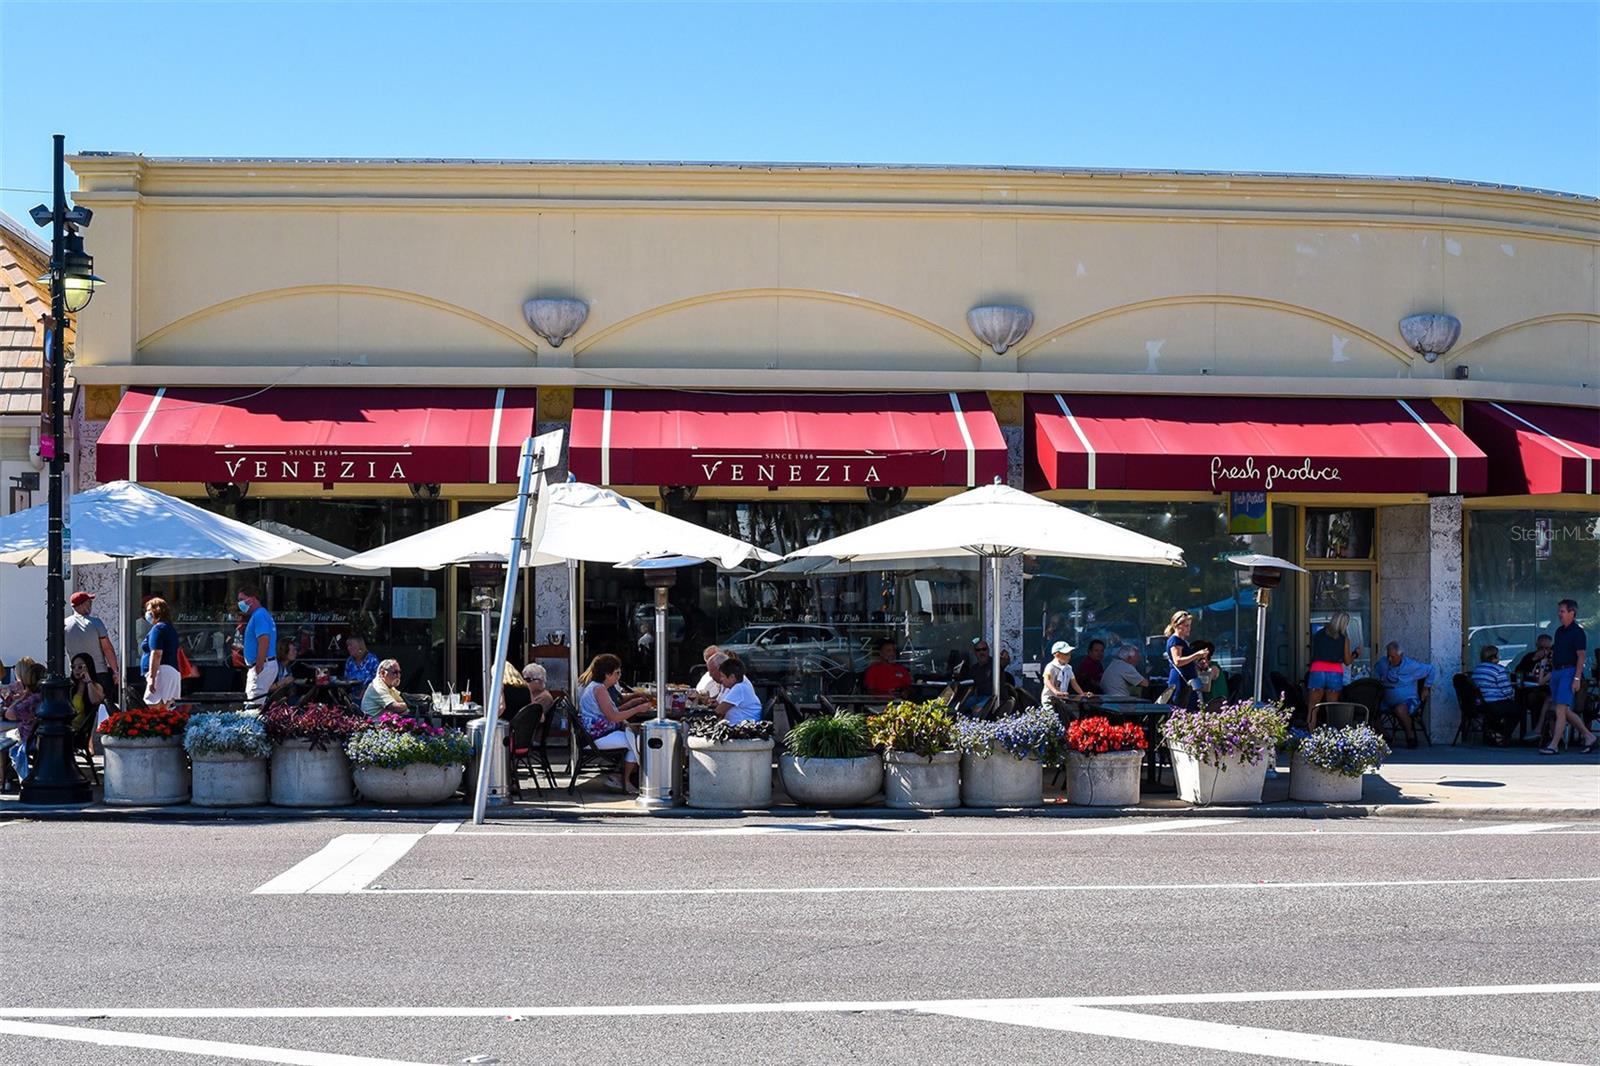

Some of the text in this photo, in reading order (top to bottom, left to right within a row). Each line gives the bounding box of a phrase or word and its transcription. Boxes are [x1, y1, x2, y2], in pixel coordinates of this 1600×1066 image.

[225, 457, 406, 479] VENEZIA
[701, 460, 881, 482] VENEZIA
[1211, 456, 1342, 490] fresh produce
